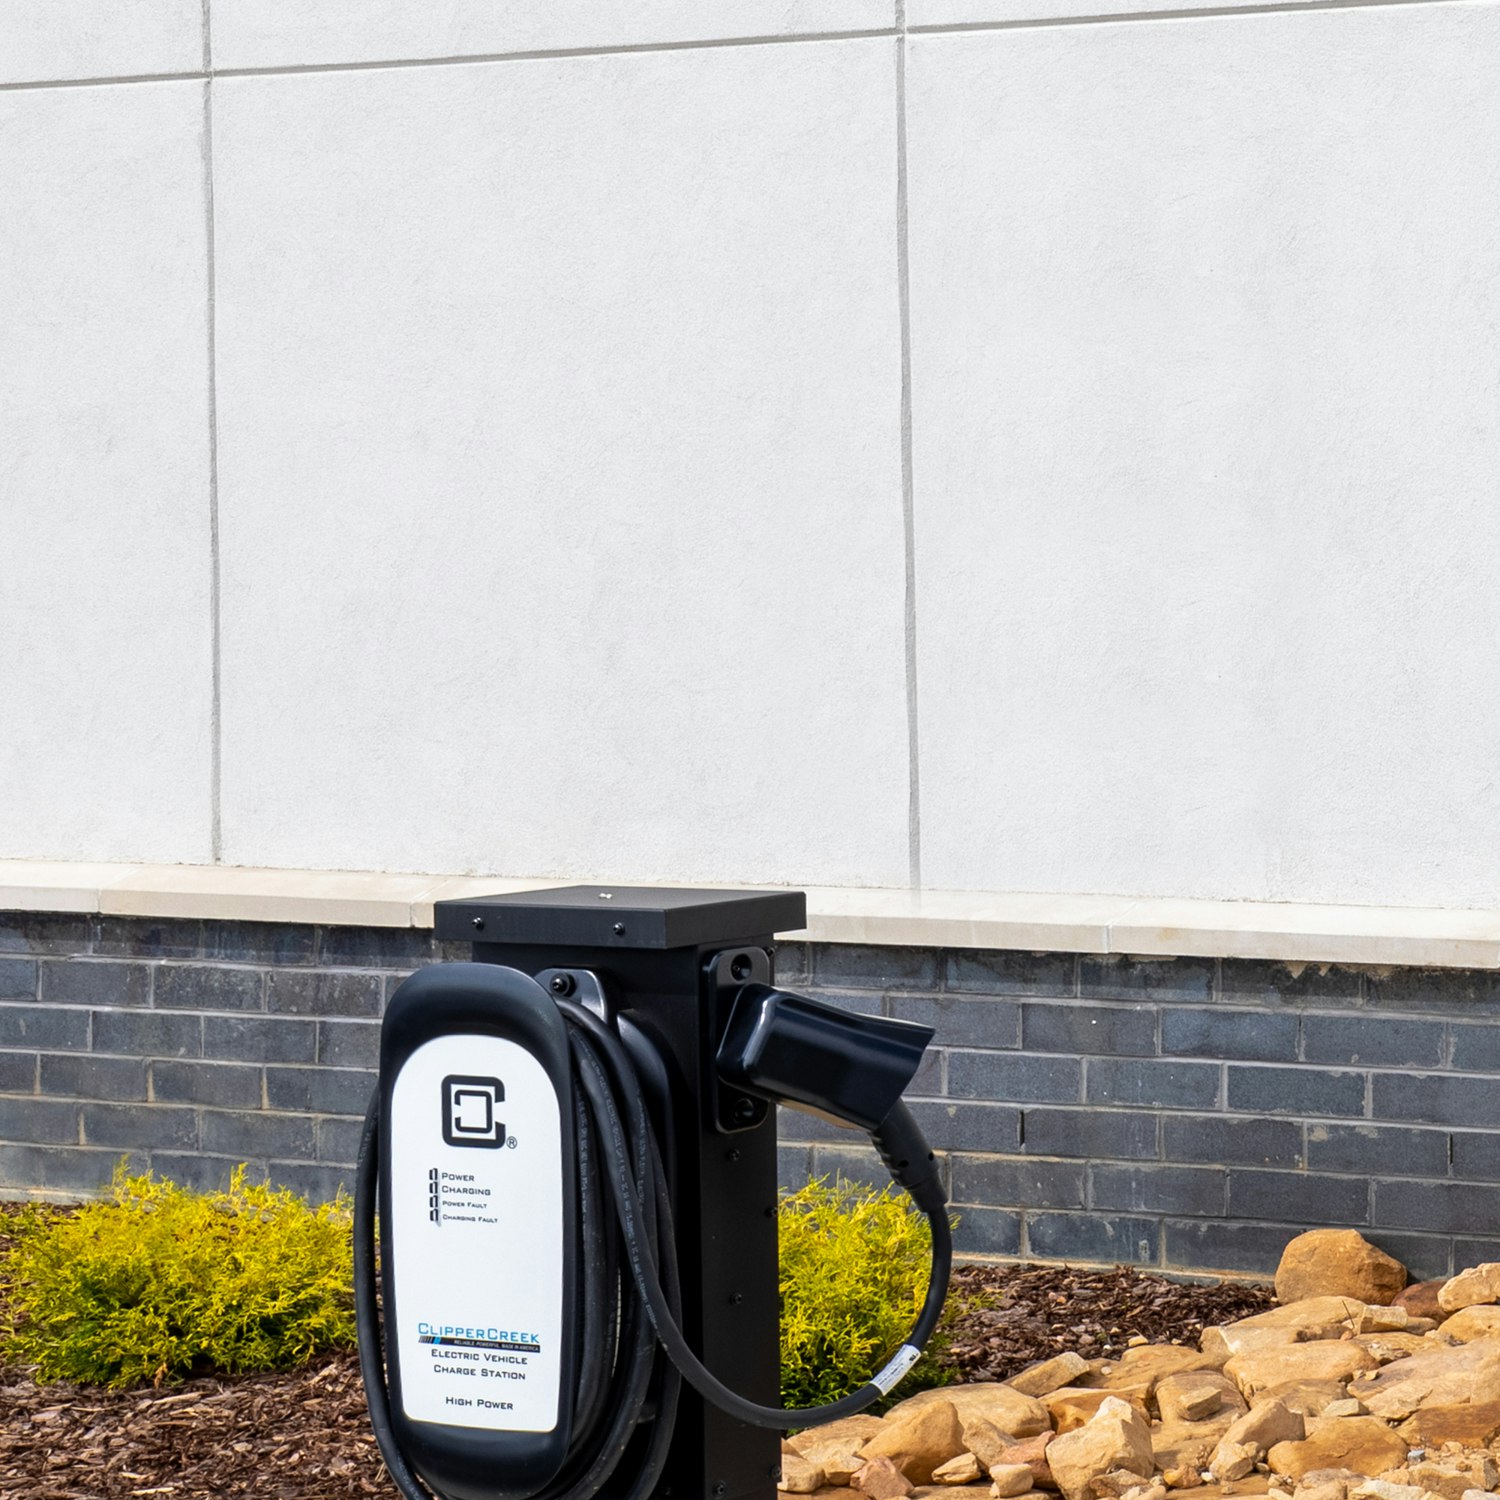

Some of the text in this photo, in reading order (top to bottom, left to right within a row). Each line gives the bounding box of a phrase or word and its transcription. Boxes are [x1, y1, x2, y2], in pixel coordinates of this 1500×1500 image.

[441, 1172, 475, 1181] POWER
[441, 1185, 491, 1196] CHARGING
[431, 1348, 528, 1365] ELECTRIC VEHICLE
[433, 1364, 526, 1380] CHARGE STATION
[445, 1396, 514, 1410] HIGH POWER
